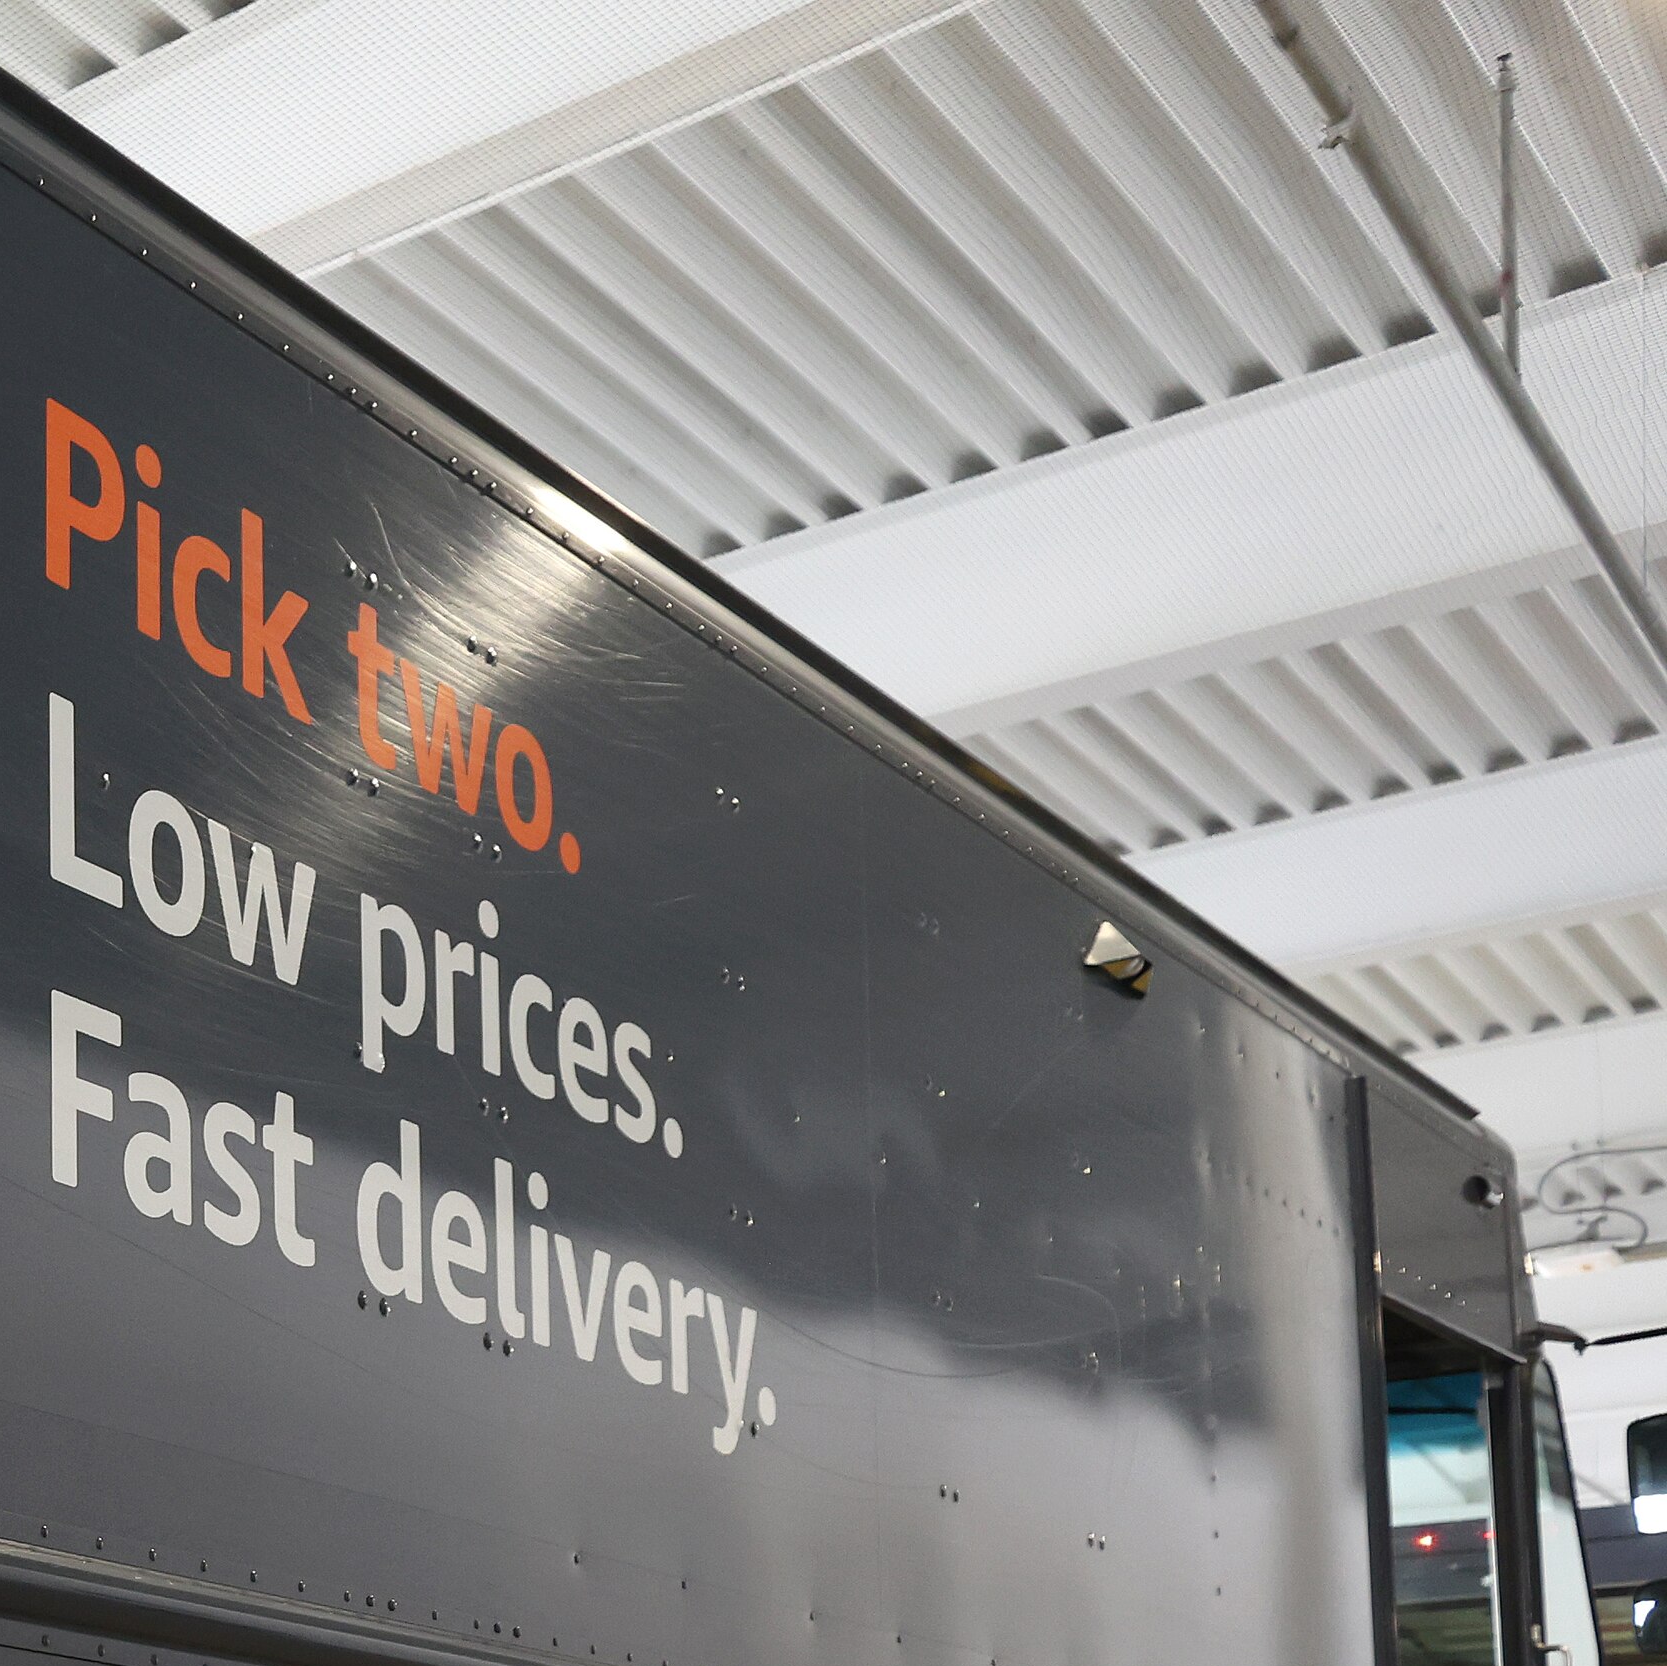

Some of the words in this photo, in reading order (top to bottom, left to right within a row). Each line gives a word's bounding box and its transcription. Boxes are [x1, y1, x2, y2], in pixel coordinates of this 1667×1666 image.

[46, 398, 313, 725] Pick
[348, 600, 580, 873] two.
[49, 692, 317, 987] Low
[360, 892, 684, 1159] prices.
[51, 990, 317, 1267] Fast
[356, 1120, 777, 1453] delivery.
